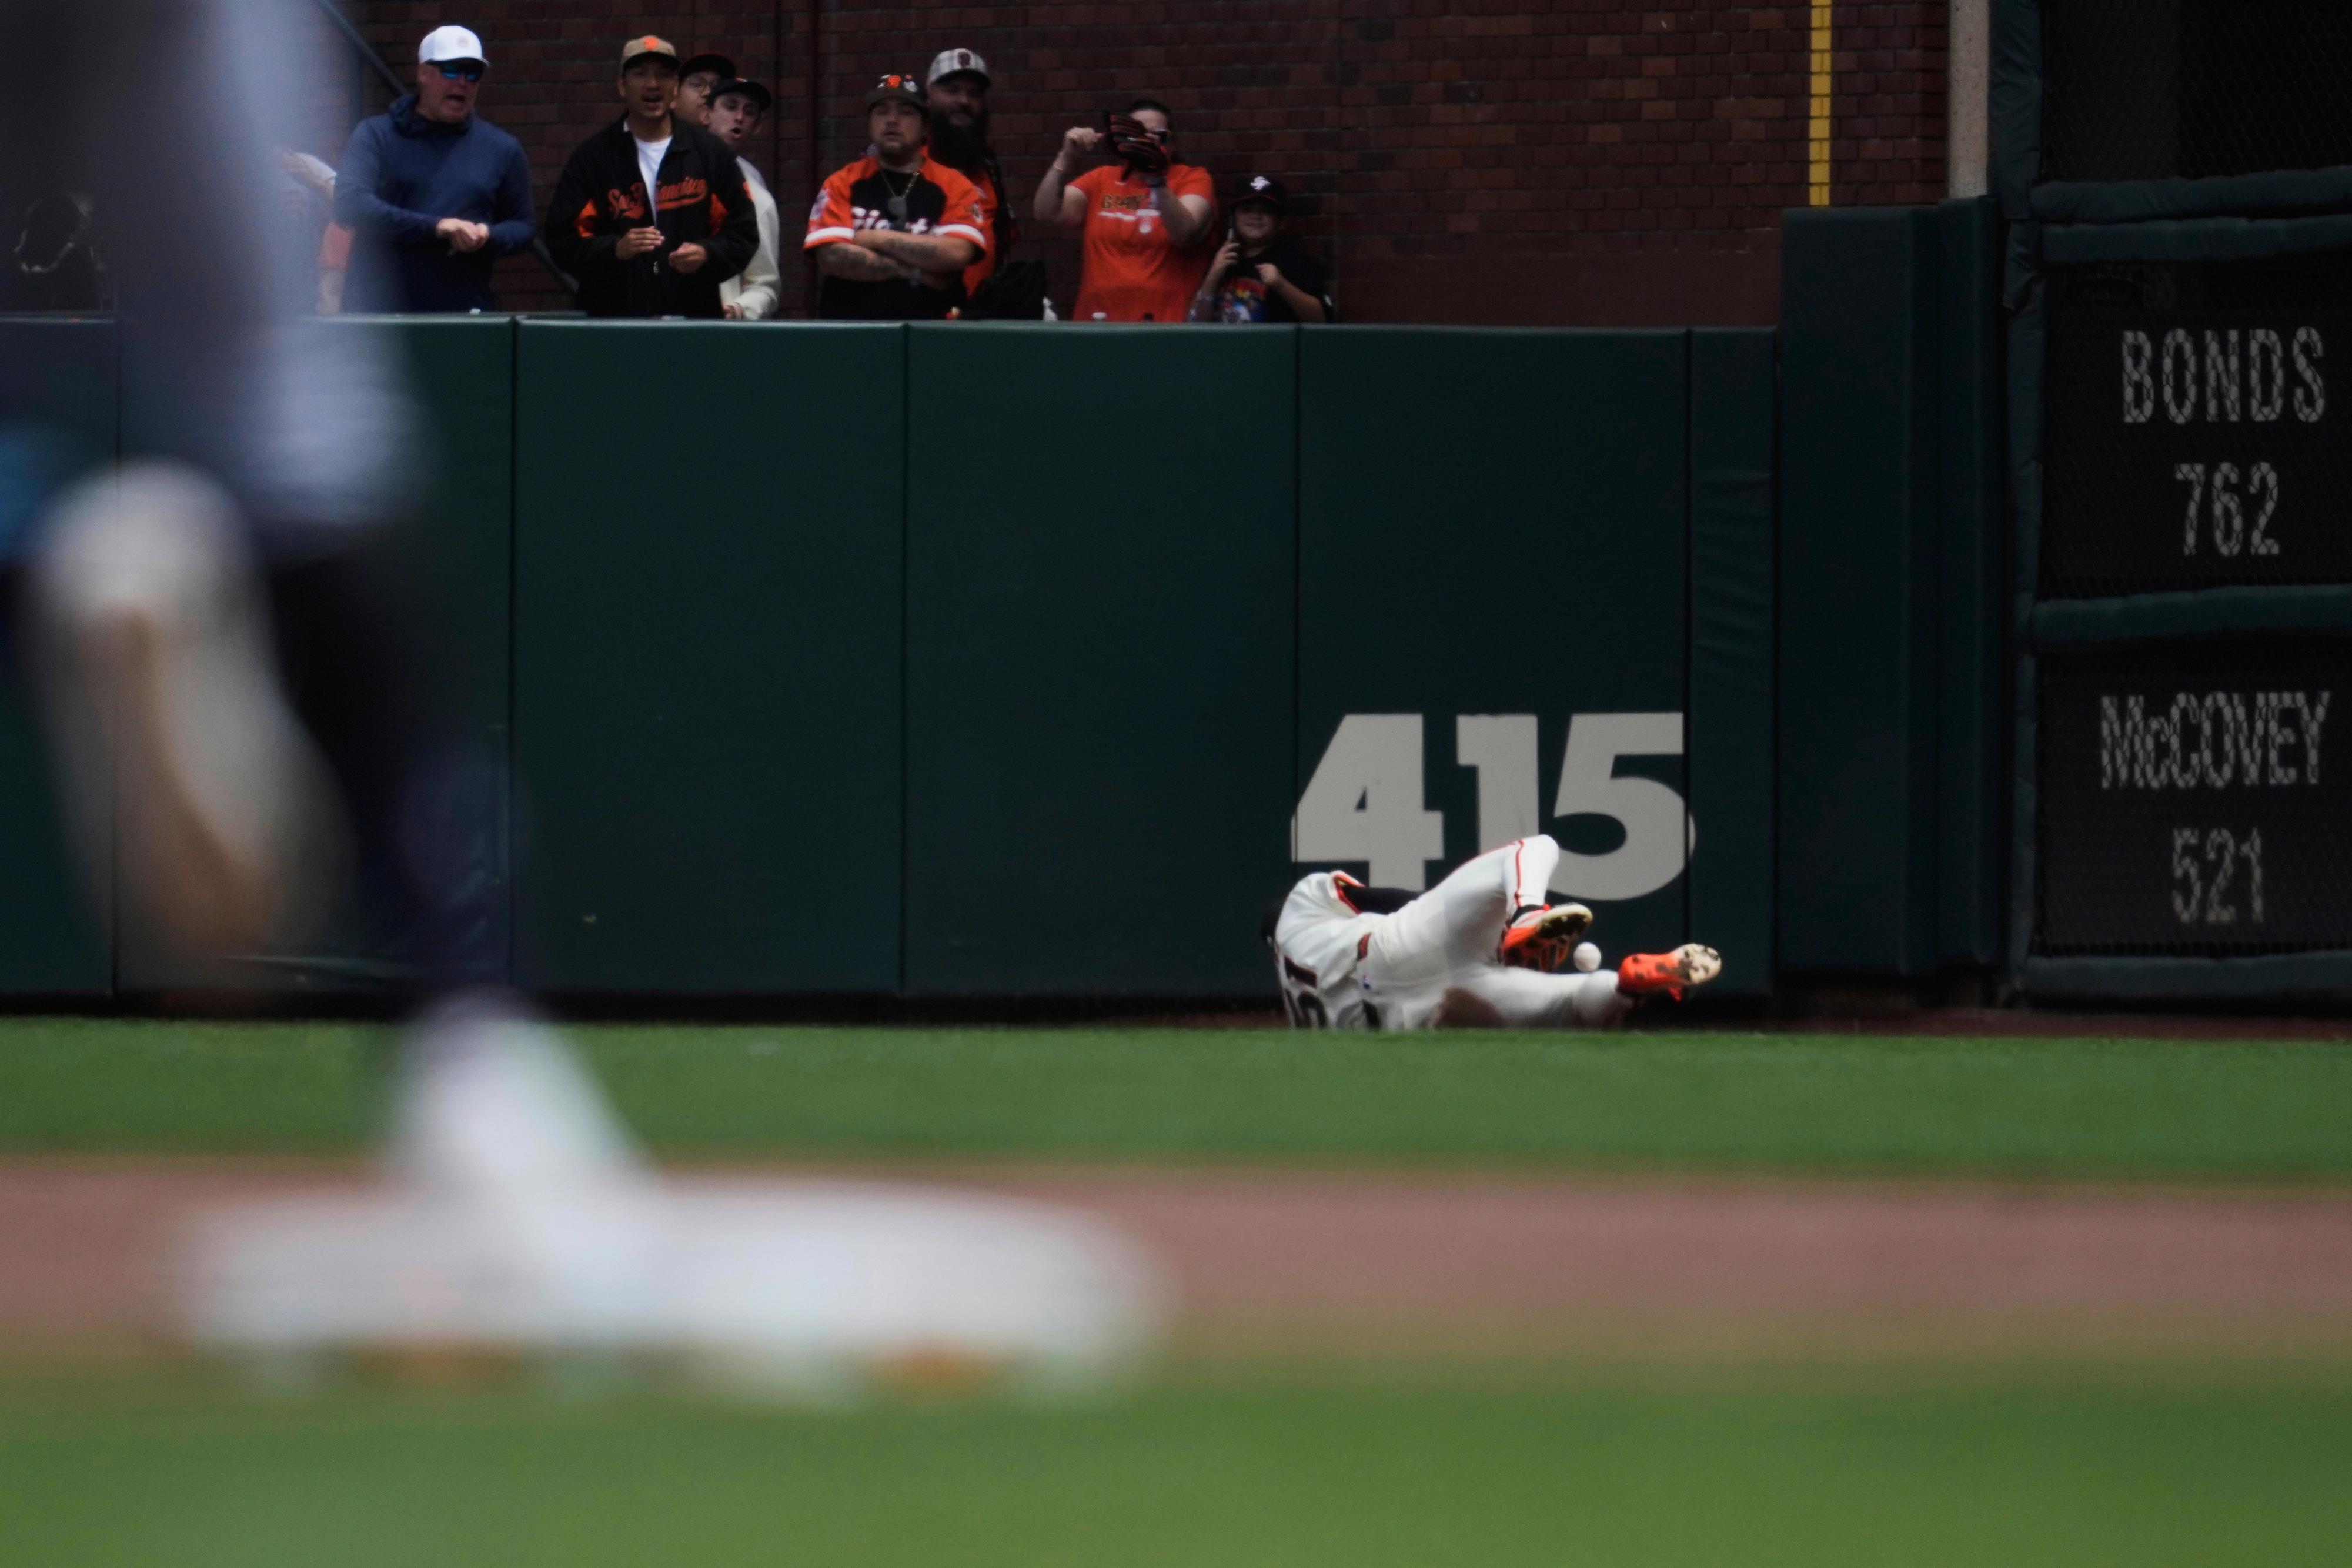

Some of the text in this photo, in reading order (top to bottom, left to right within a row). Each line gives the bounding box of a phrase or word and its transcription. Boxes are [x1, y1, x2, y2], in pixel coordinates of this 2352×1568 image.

[2122, 326, 2326, 424] BONDS
[2175, 462, 2280, 556] 762
[2100, 691, 2330, 789] McCOVEY
[1291, 713, 1695, 900] 415
[2172, 828, 2264, 923] 521
